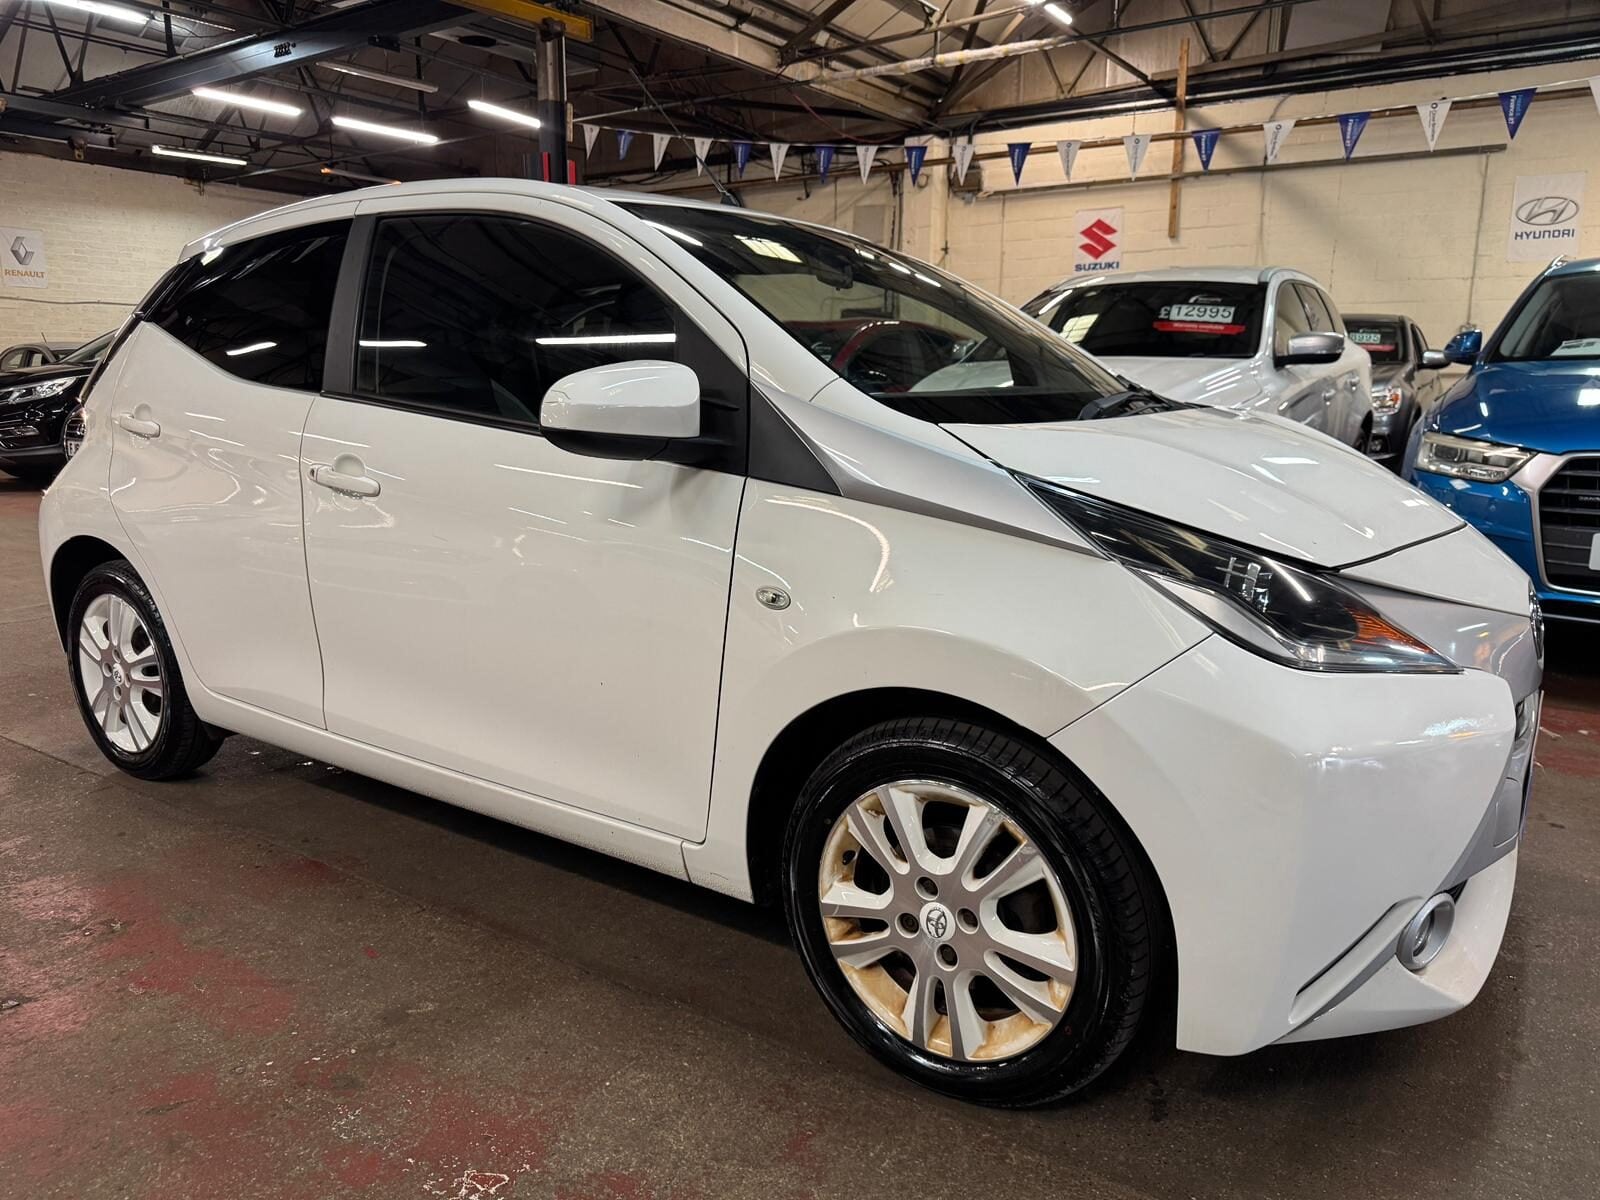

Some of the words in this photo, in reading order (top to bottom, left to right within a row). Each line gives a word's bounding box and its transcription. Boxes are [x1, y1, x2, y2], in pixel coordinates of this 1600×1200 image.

[1514, 229, 1575, 240] HYUNDAI
[1074, 261, 1120, 272] SUZUKI
[4, 269, 45, 278] RENAULT
